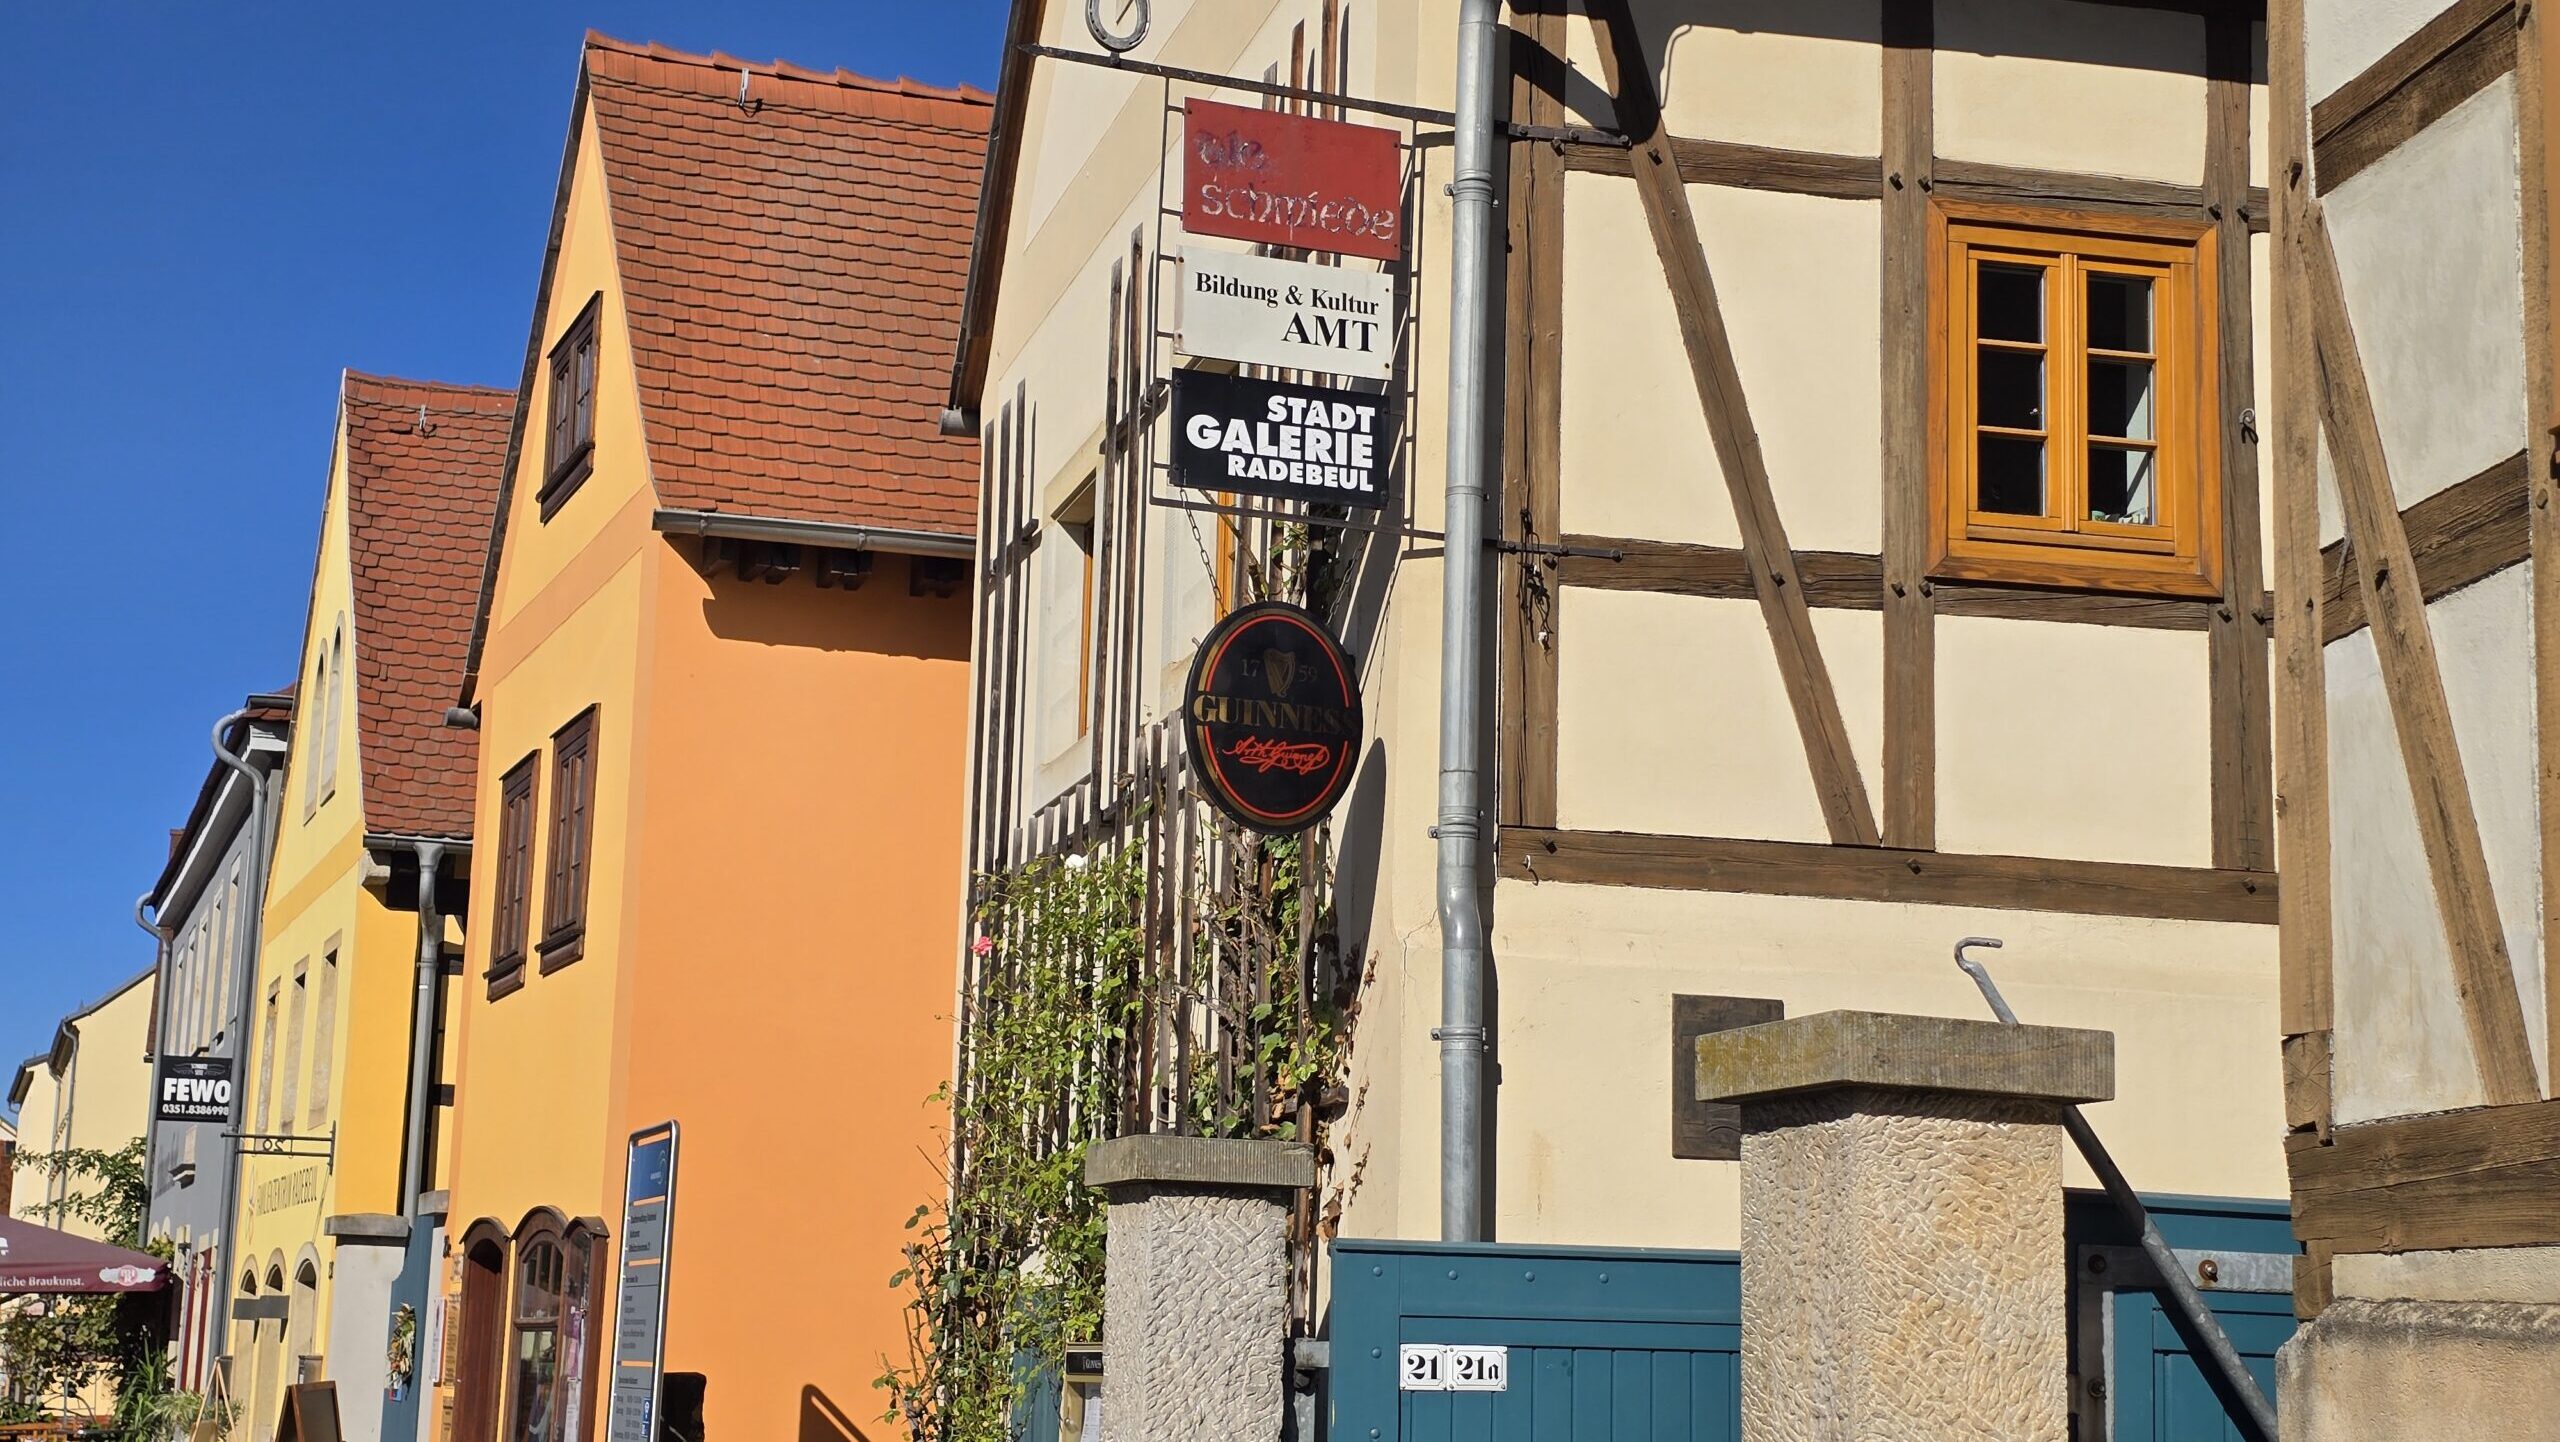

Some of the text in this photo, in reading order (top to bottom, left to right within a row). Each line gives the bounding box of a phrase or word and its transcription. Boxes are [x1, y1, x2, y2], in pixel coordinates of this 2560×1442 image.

[1195, 271, 1379, 315] Bildung & Kultur
[1281, 311, 1379, 353] AMT
[1267, 395, 1376, 433] STADT
[1186, 414, 1374, 469] GALERIE
[1227, 454, 1374, 492] RADEBEUL
[1193, 693, 1358, 738] GUINNESS
[163, 1077, 231, 1104] FEWO
[28, 1275, 84, 1286] Braukunst.
[1407, 1354, 1499, 1380] 21 21a
